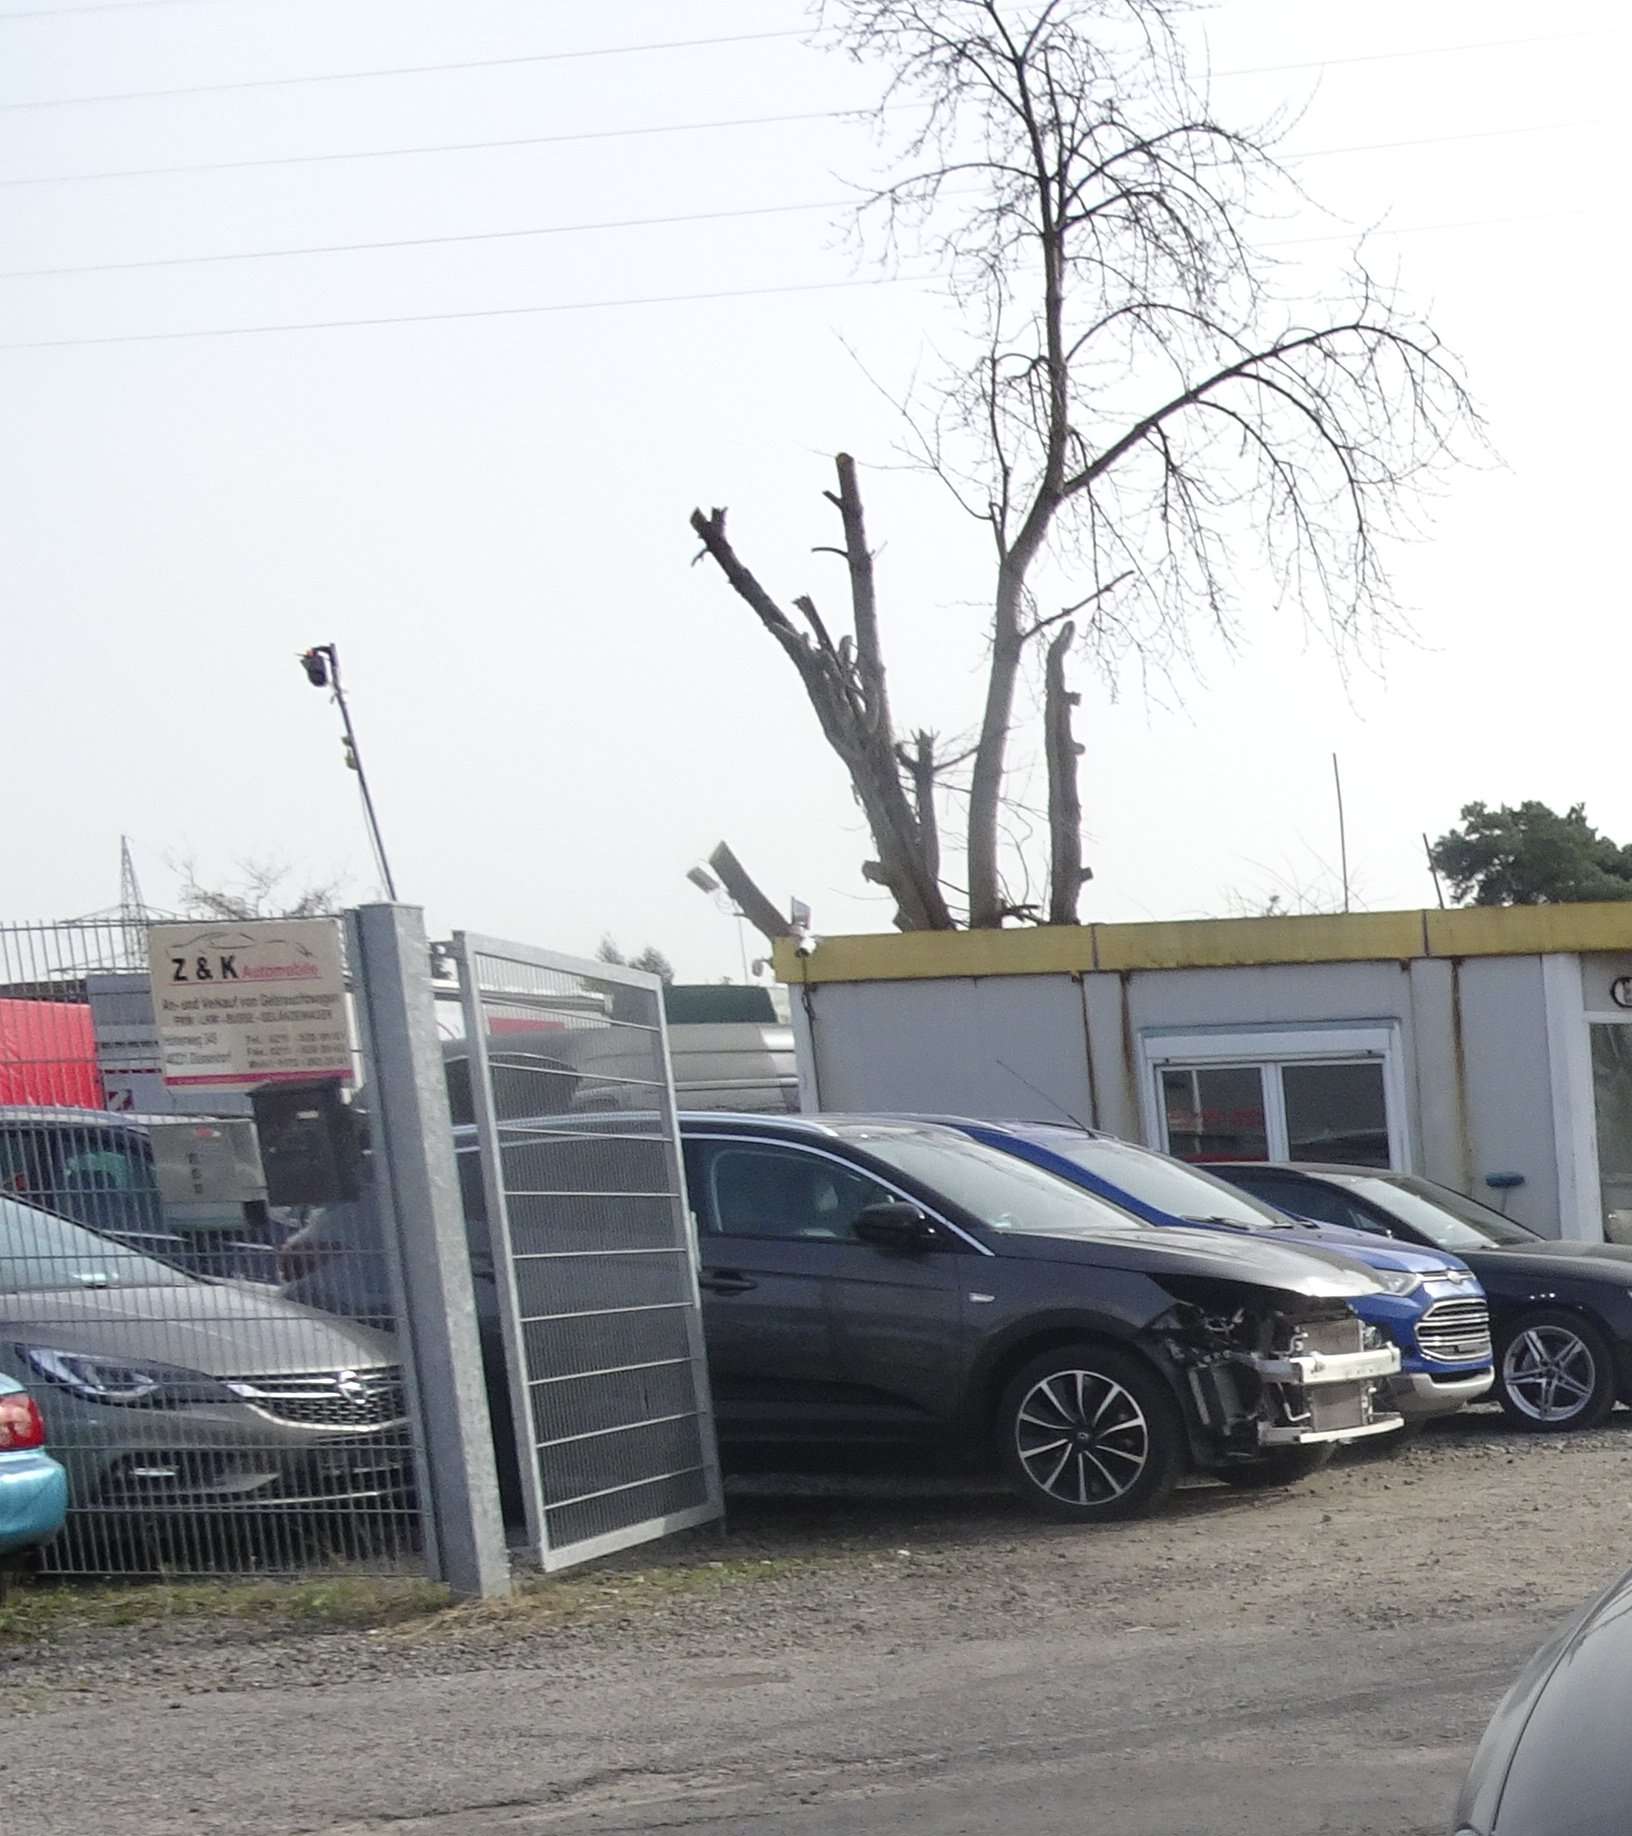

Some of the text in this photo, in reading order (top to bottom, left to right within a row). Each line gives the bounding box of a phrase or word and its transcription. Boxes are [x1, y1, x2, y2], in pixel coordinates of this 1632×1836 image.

[172, 958, 188, 981] Z
[196, 957, 213, 980] &
[220, 956, 239, 979] K
